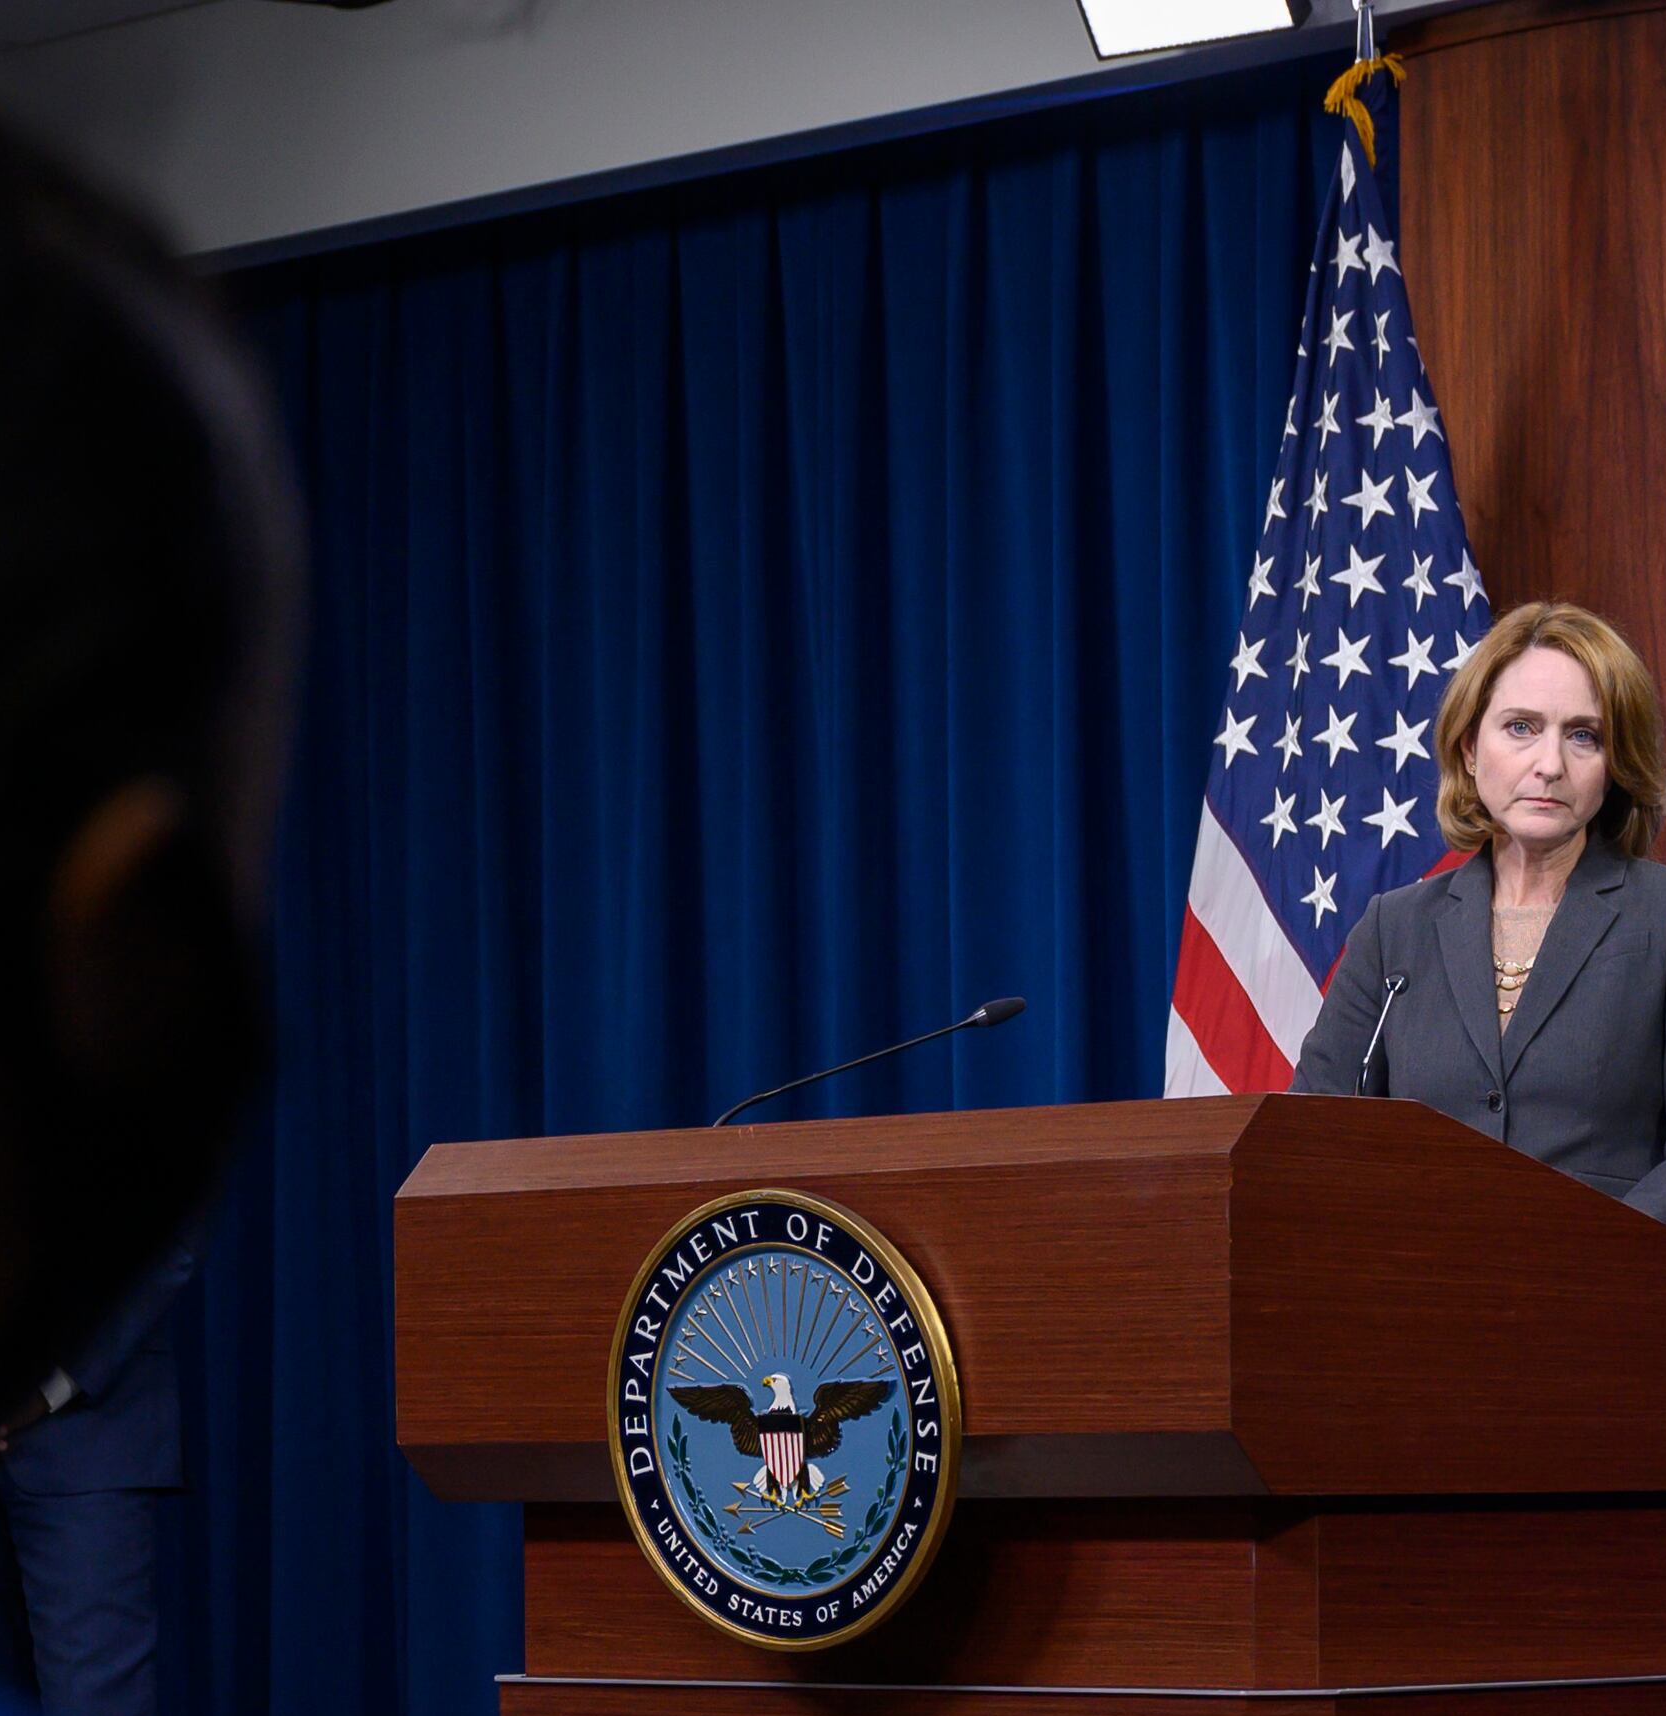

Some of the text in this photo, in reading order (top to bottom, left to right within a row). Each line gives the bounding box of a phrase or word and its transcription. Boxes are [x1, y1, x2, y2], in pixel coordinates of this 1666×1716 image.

[626, 1210, 939, 1476] DEPARTMENT OF DEFENSE
[657, 1517, 918, 1626] UNITED STATES OF AMERICA
